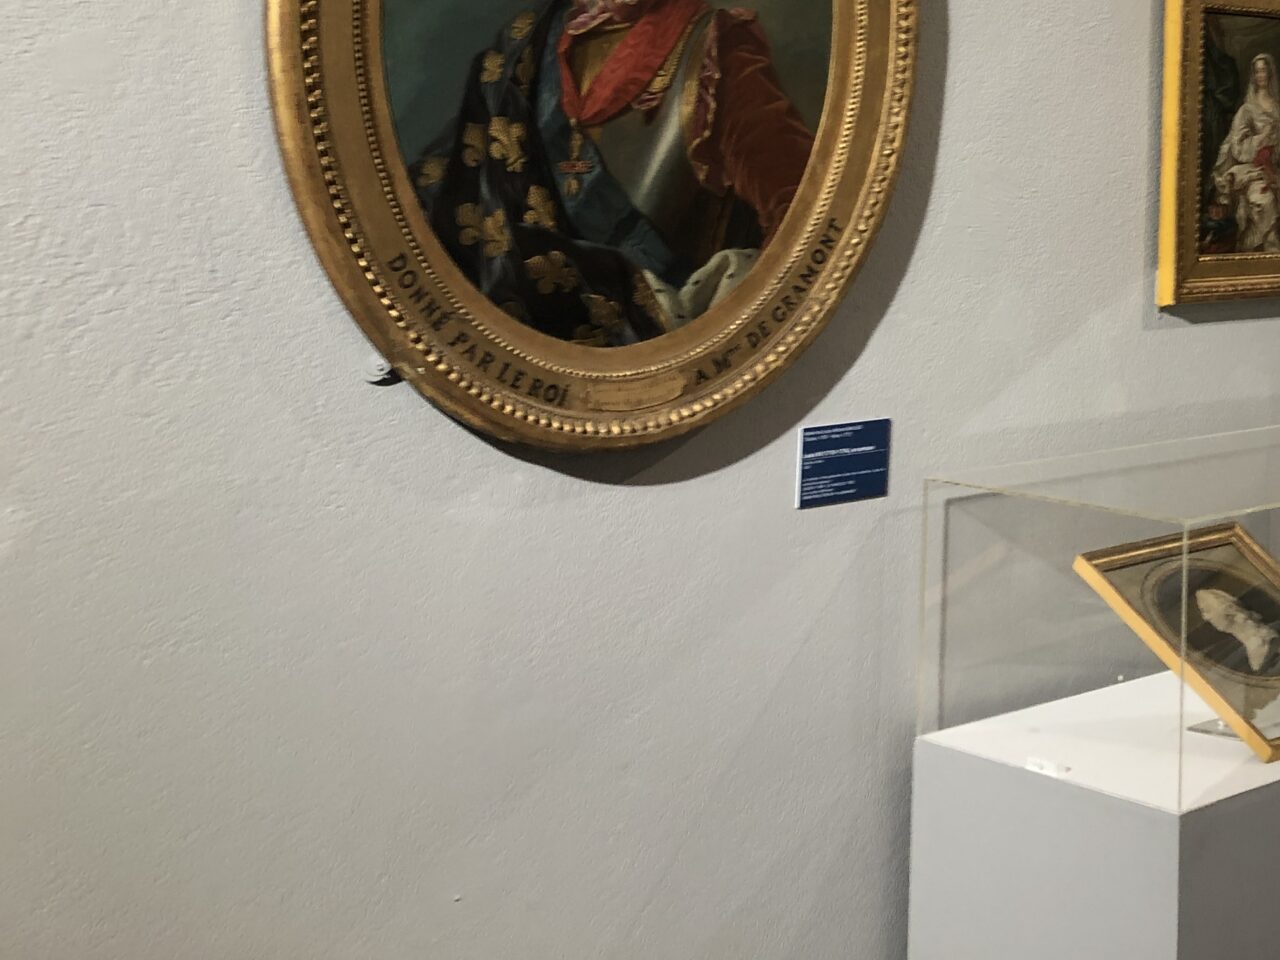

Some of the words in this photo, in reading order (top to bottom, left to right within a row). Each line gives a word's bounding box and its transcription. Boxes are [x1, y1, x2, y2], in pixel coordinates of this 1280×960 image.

[745, 319, 774, 350] DE
[771, 216, 844, 323] GRAMONT
[494, 361, 529, 390] LE
